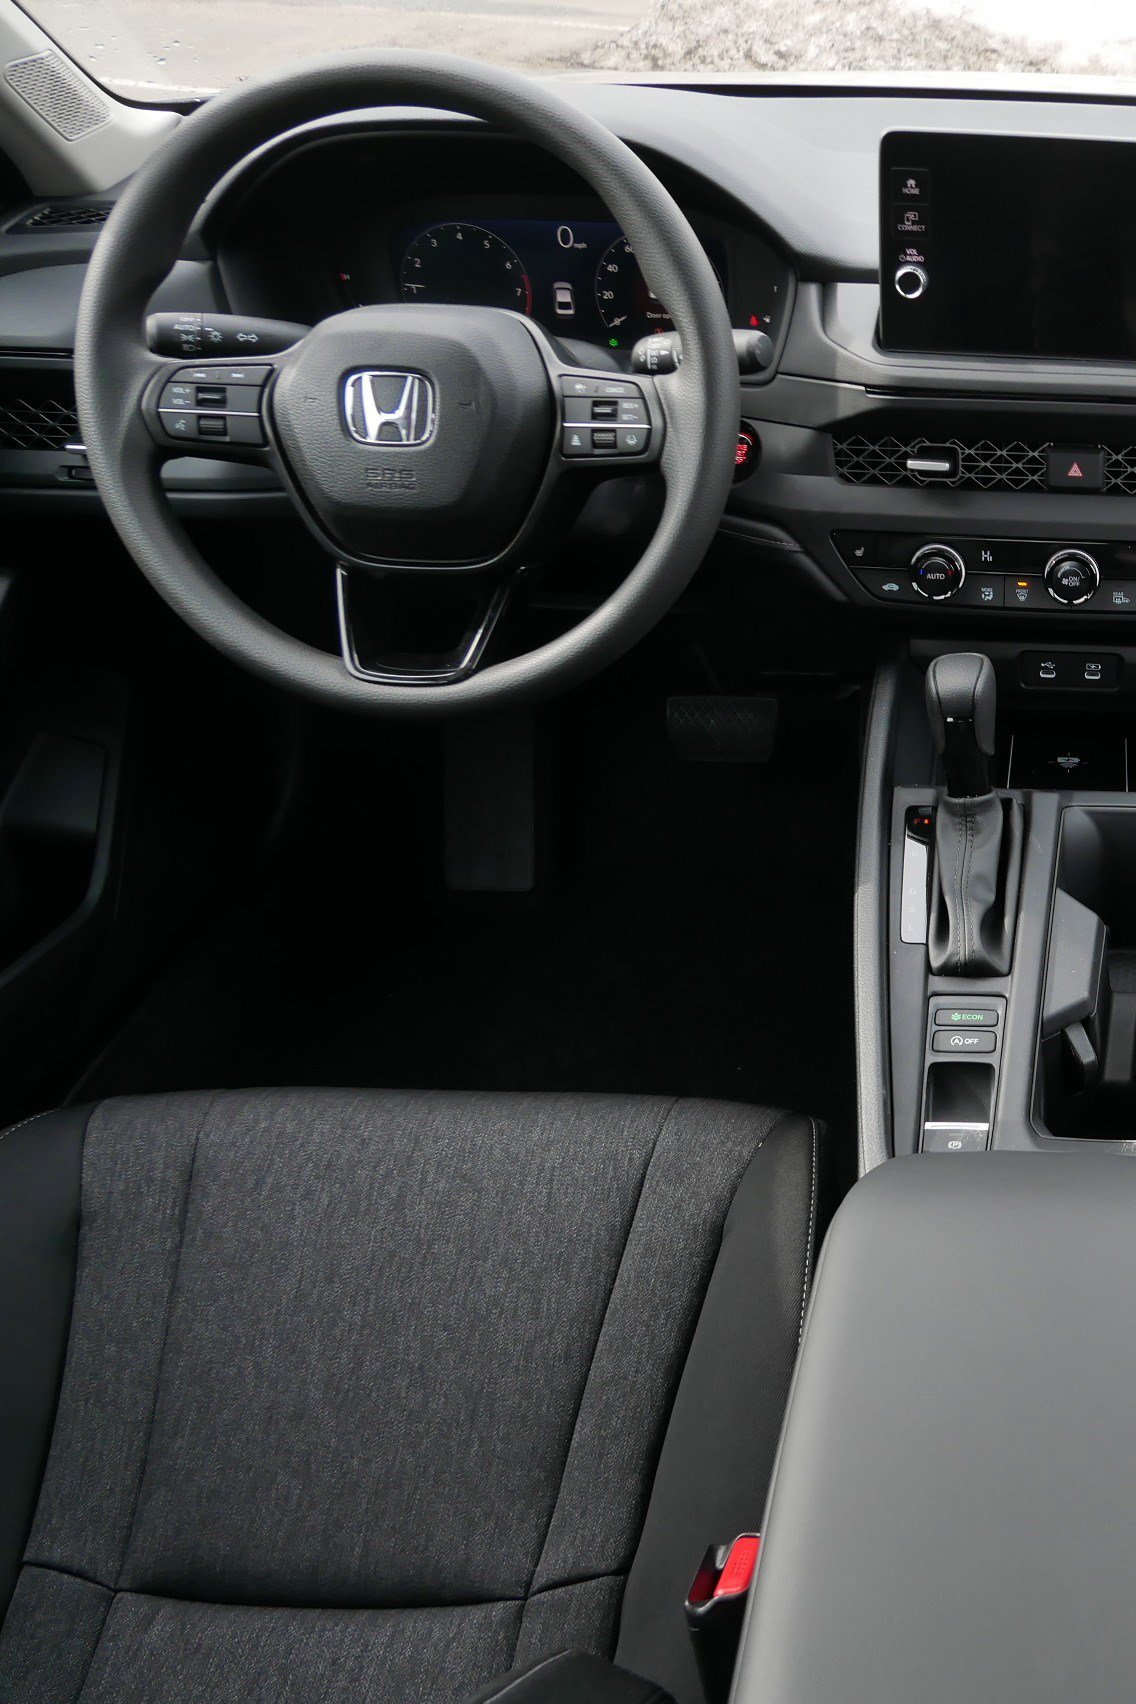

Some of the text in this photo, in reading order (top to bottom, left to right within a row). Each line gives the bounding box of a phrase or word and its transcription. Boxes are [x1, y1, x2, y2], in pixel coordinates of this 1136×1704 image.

[902, 187, 920, 195] HOME
[897, 224, 926, 232] CONNECT
[456, 232, 463, 240] 4
[556, 225, 588, 250] 0 mph
[430, 238, 438, 248] 3
[482, 239, 491, 249] 5
[414, 257, 422, 268] 2
[505, 261, 512, 270] 6
[607, 264, 619, 273] 40
[515, 287, 522, 297] 7
[602, 290, 614, 300] 20
[173, 323, 196, 331] AUTO
[926, 573, 945, 581] AUTO
[962, 1013, 984, 1021] ECON
[964, 1037, 979, 1045] OFF
